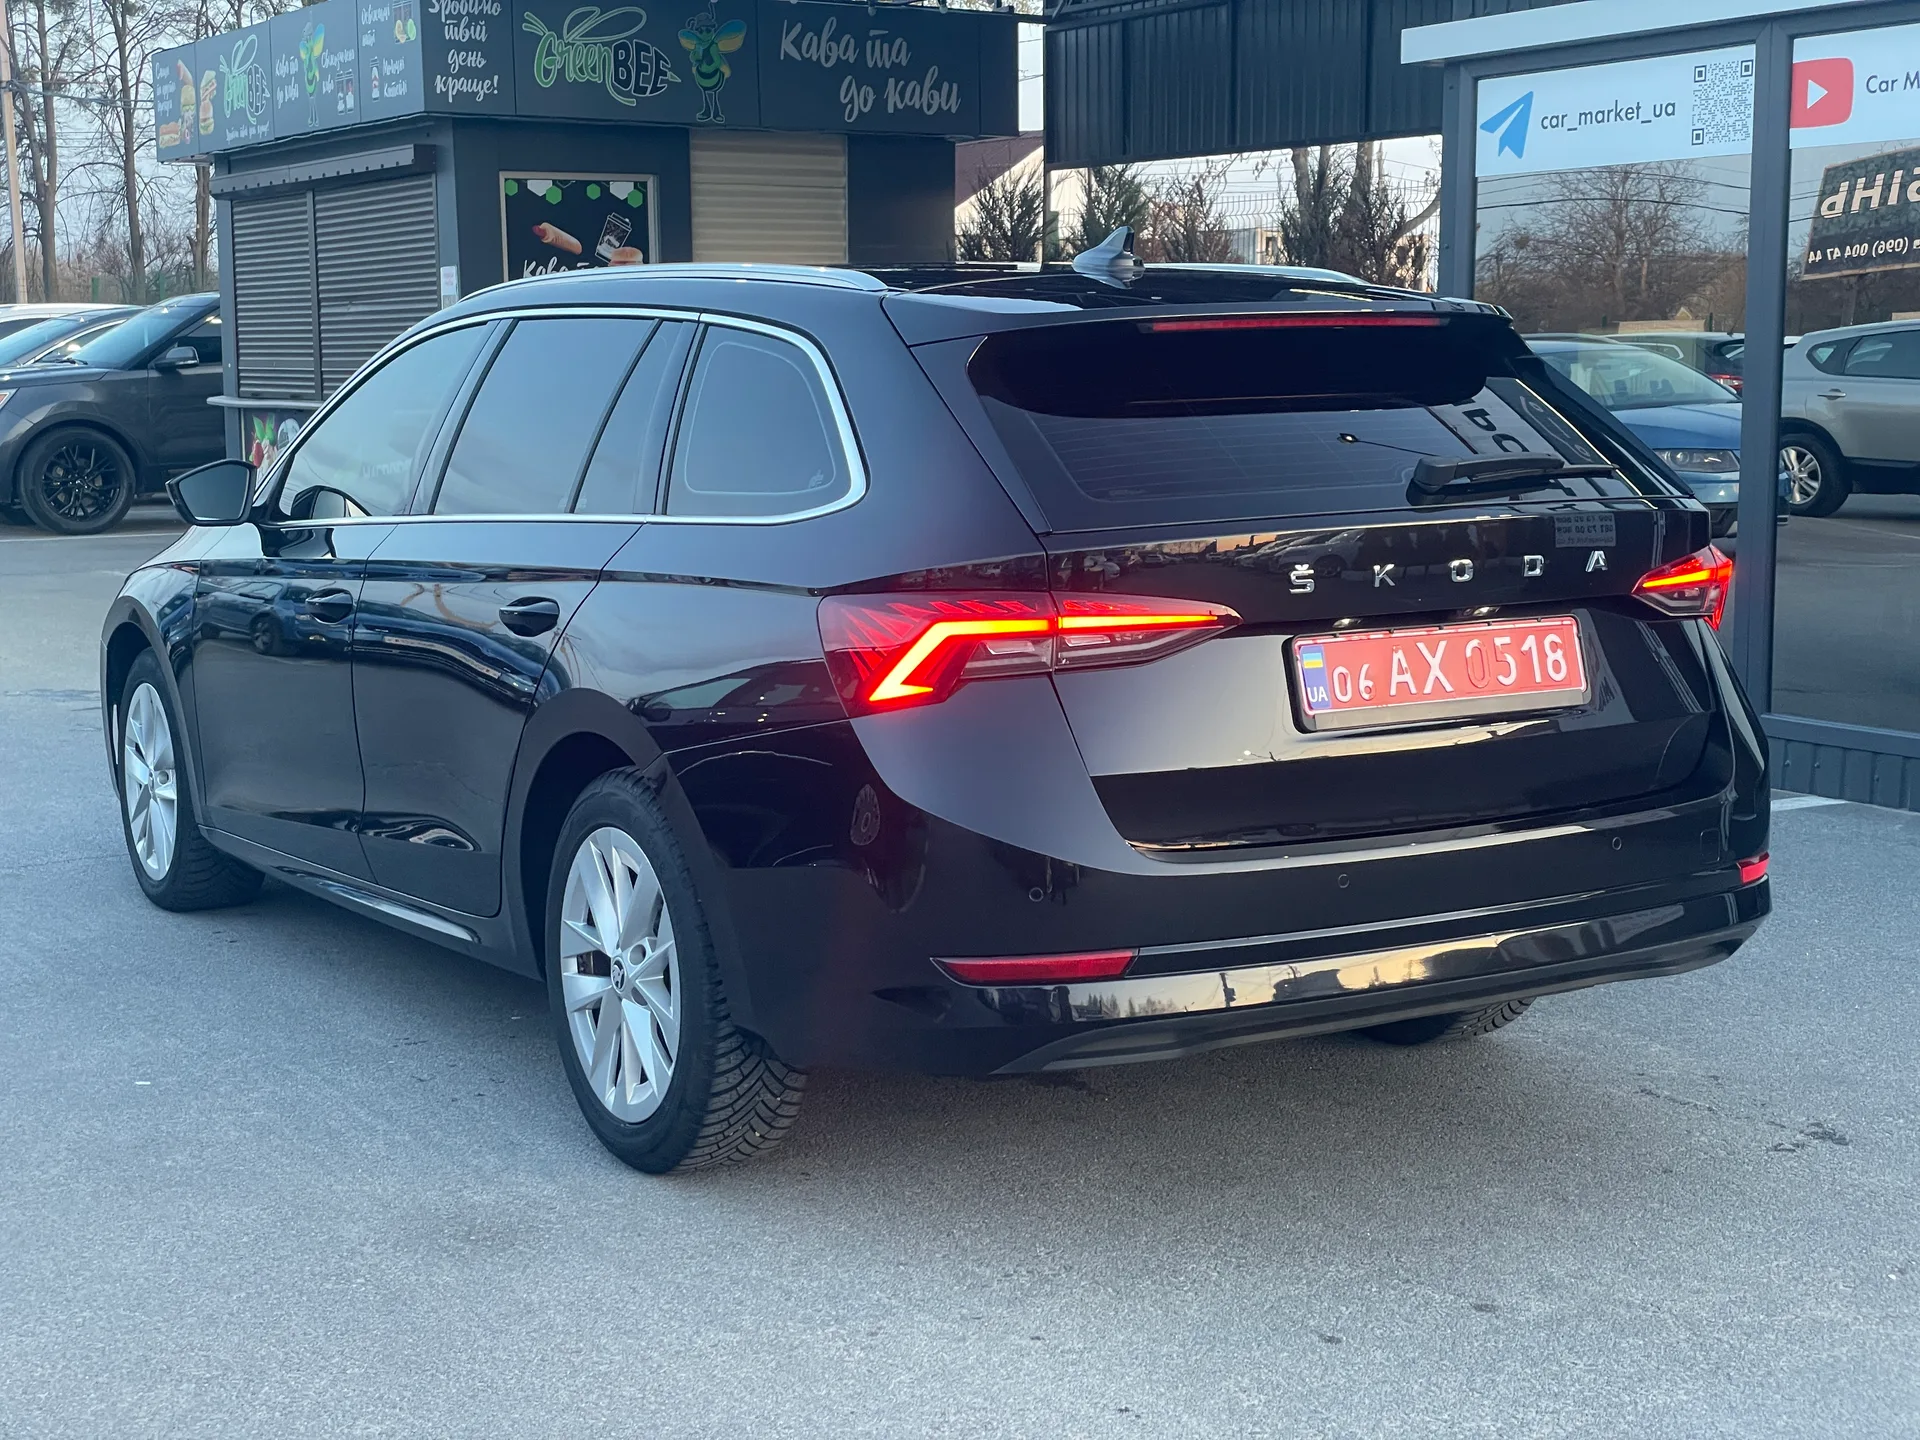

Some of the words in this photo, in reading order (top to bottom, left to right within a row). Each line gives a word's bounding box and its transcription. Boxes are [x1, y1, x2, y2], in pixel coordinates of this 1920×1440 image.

[444, 17, 487, 42] твій
[780, 16, 859, 68] Кава
[866, 29, 911, 69] та
[448, 49, 486, 74] день
[434, 74, 499, 103] краще!
[839, 75, 876, 123] до
[884, 65, 961, 115] кави
[1866, 74, 1898, 94] Car
[1540, 99, 1676, 131] car_market_ua
[523, 256, 569, 278] Кав
[1289, 549, 1608, 594] ŠKODA
[1332, 663, 1377, 703] 06
[1465, 633, 1568, 689] 0518
[1306, 686, 1329, 703] UA
